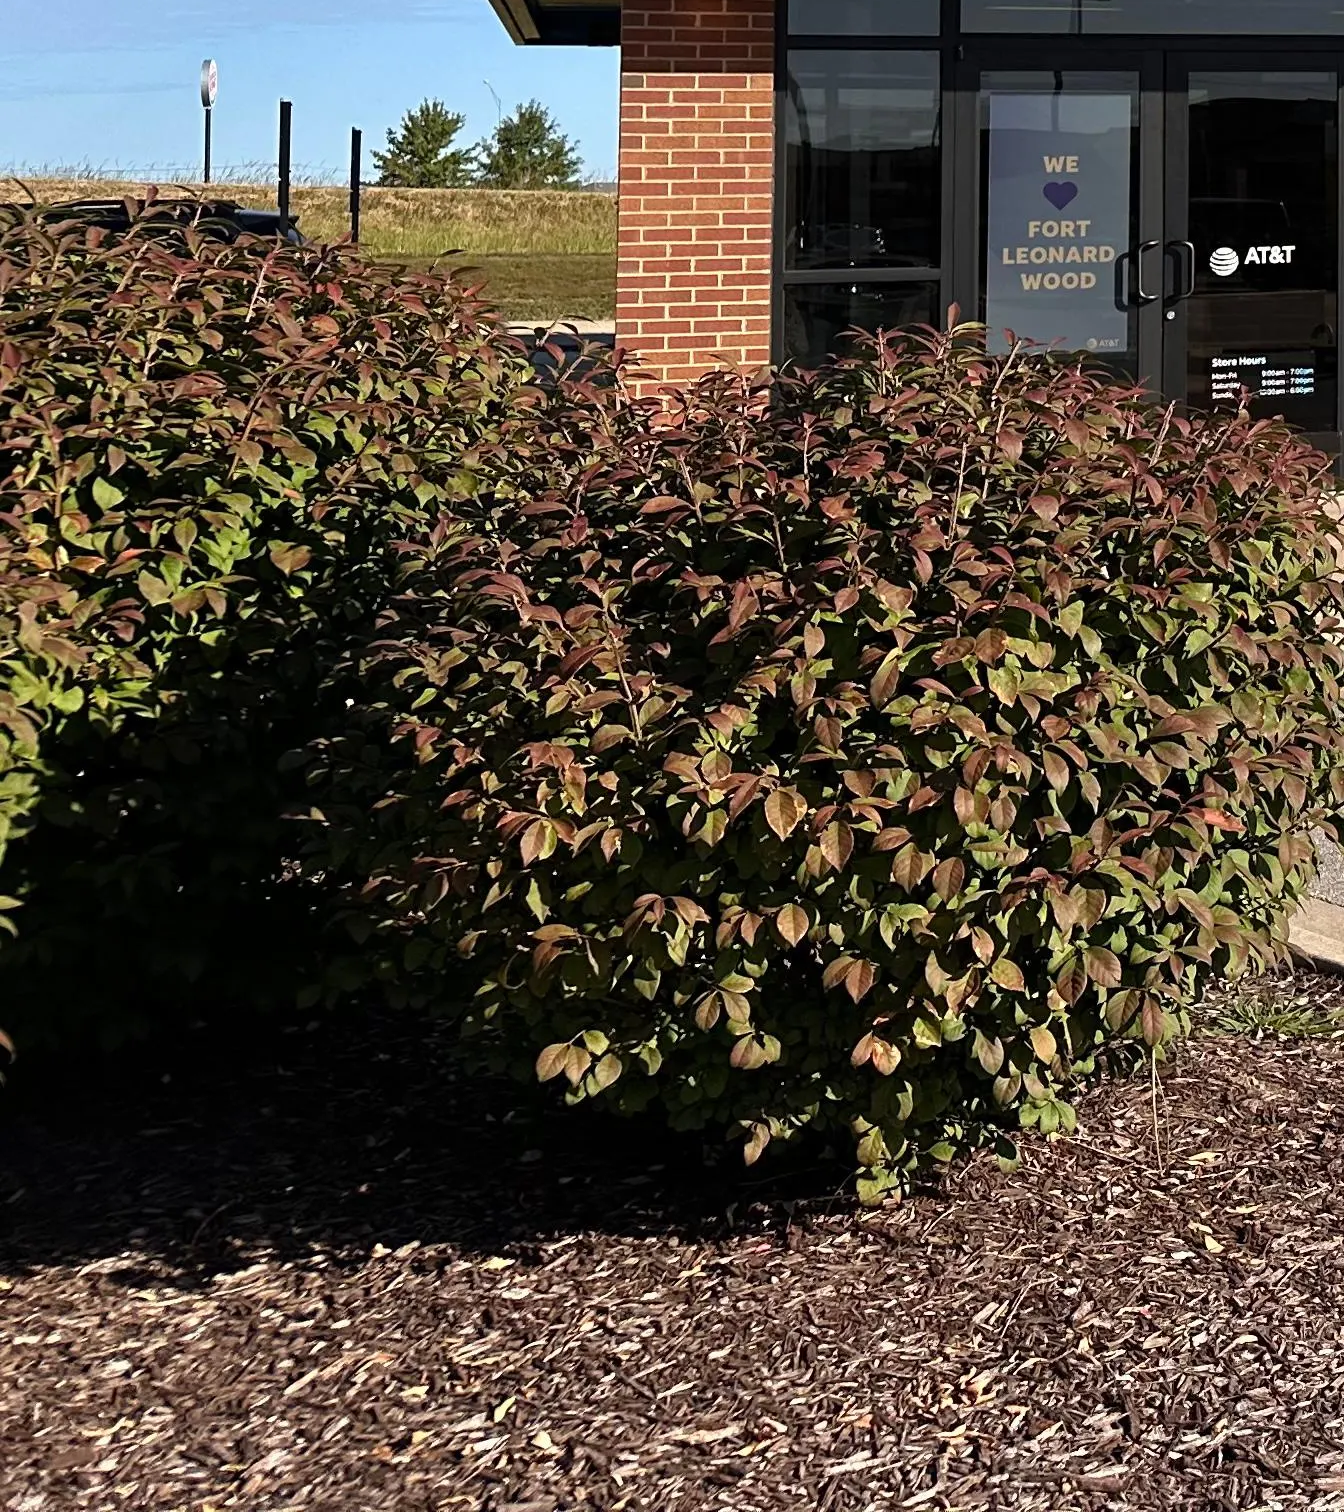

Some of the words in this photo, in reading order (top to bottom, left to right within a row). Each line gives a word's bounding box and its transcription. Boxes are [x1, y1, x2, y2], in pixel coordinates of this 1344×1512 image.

[1043, 155, 1080, 173] WE
[1028, 220, 1091, 238] FORT
[1002, 245, 1115, 265] LEONARD
[1244, 245, 1296, 264] AT&T
[1020, 272, 1096, 291] WOOD
[1212, 358, 1237, 367] Store
[1239, 356, 1266, 366] Hours
